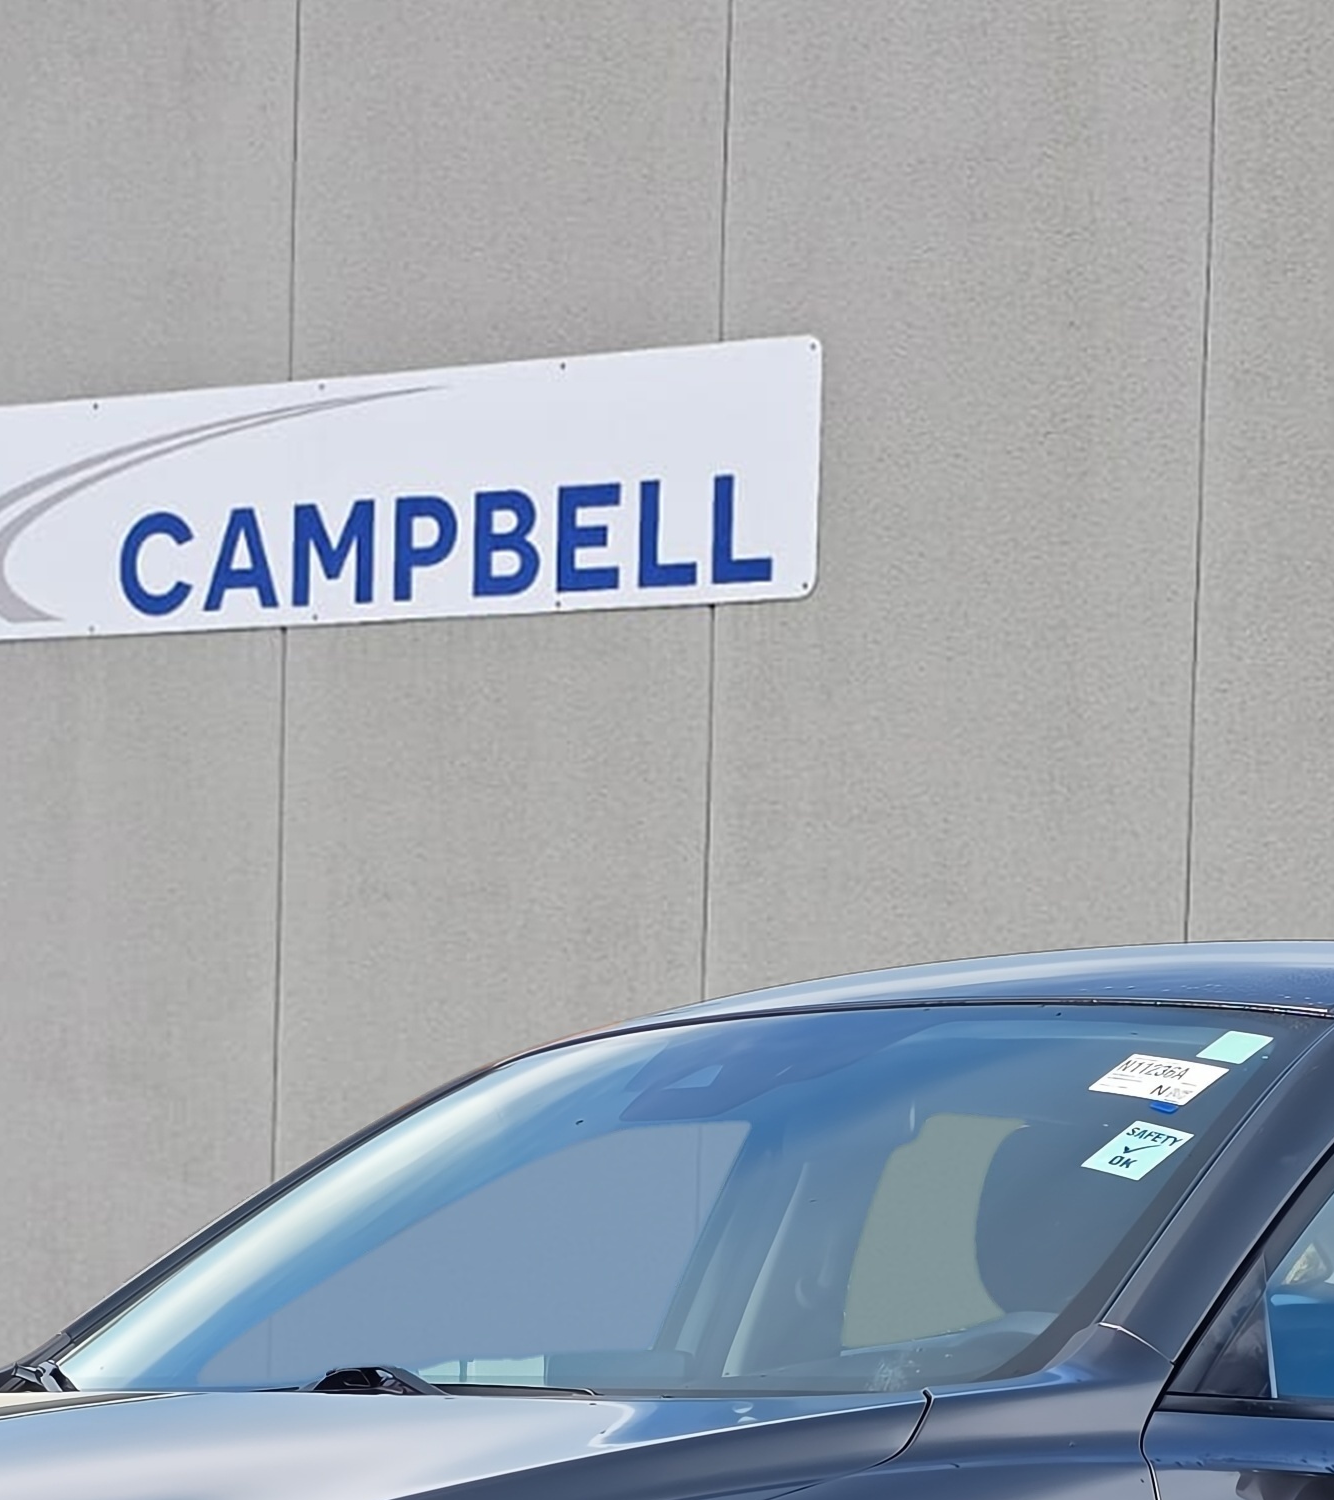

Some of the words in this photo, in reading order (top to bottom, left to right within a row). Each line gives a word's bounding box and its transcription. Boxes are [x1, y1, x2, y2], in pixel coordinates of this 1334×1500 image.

[119, 474, 774, 617] CAMPBELL
[1126, 1127, 1183, 1147] SAFETY
[1108, 1156, 1137, 1169] OK
